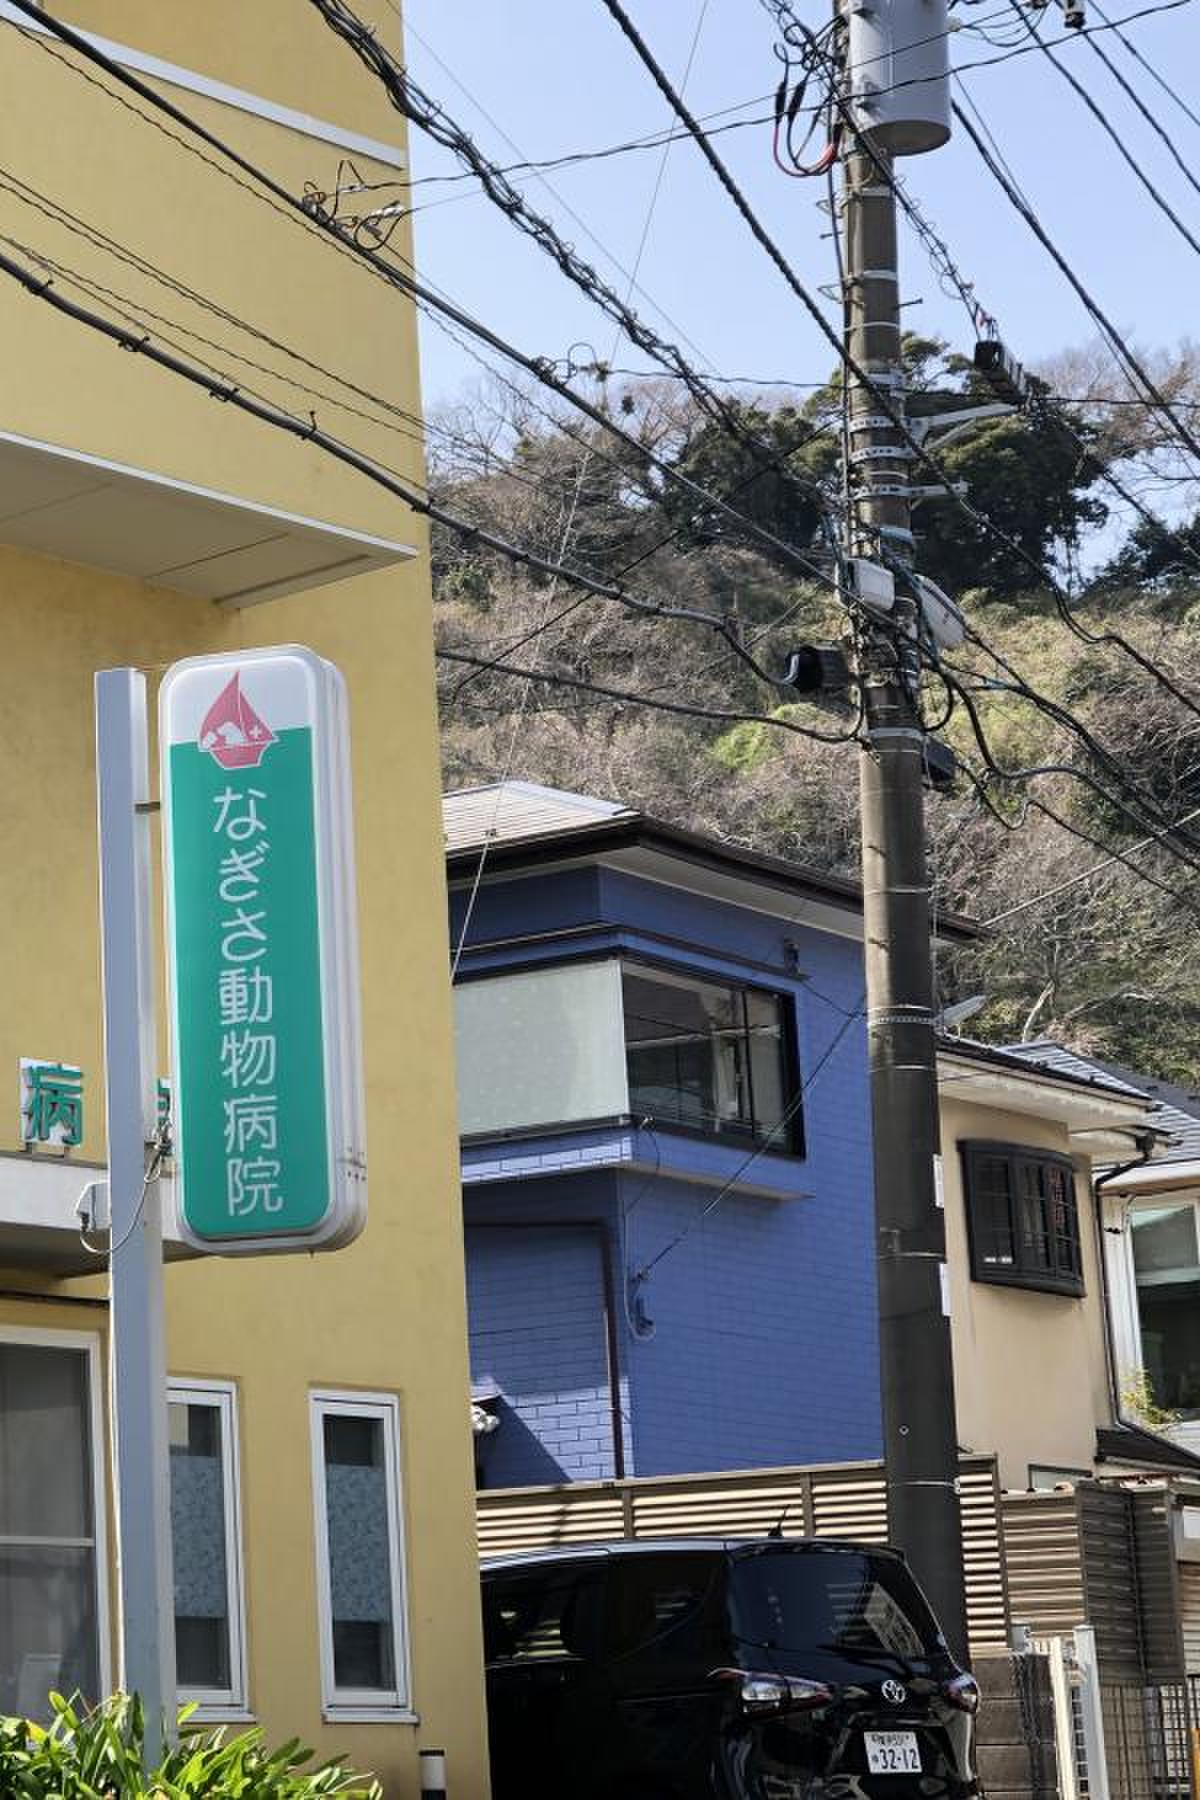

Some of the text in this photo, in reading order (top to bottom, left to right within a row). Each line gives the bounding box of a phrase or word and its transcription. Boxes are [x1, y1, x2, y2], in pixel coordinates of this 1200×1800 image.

[212, 786, 283, 1216] なぎさ動物病院
